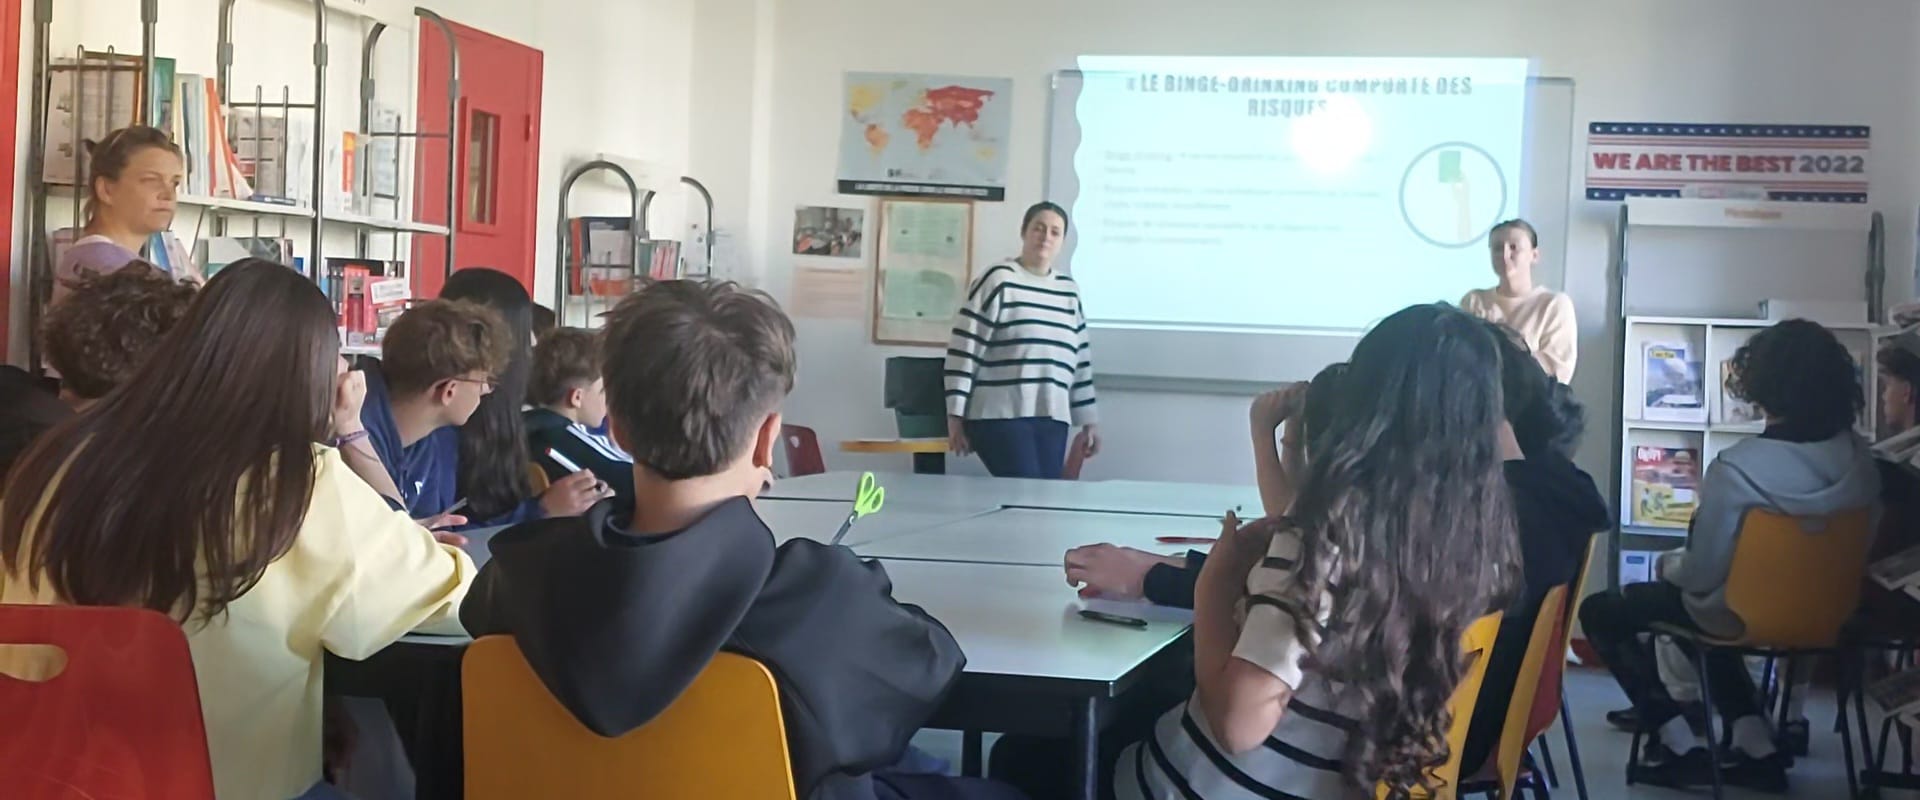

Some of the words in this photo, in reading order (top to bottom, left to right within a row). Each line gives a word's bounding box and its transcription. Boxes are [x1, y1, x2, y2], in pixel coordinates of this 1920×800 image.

[1141, 73, 1158, 92] LE
[1436, 76, 1472, 96] DES
[1593, 153, 1630, 170] WE
[1636, 153, 1682, 171] ARE
[1686, 154, 1731, 172] THE
[1735, 155, 1795, 173] BEST
[1799, 155, 1865, 174] 2022
